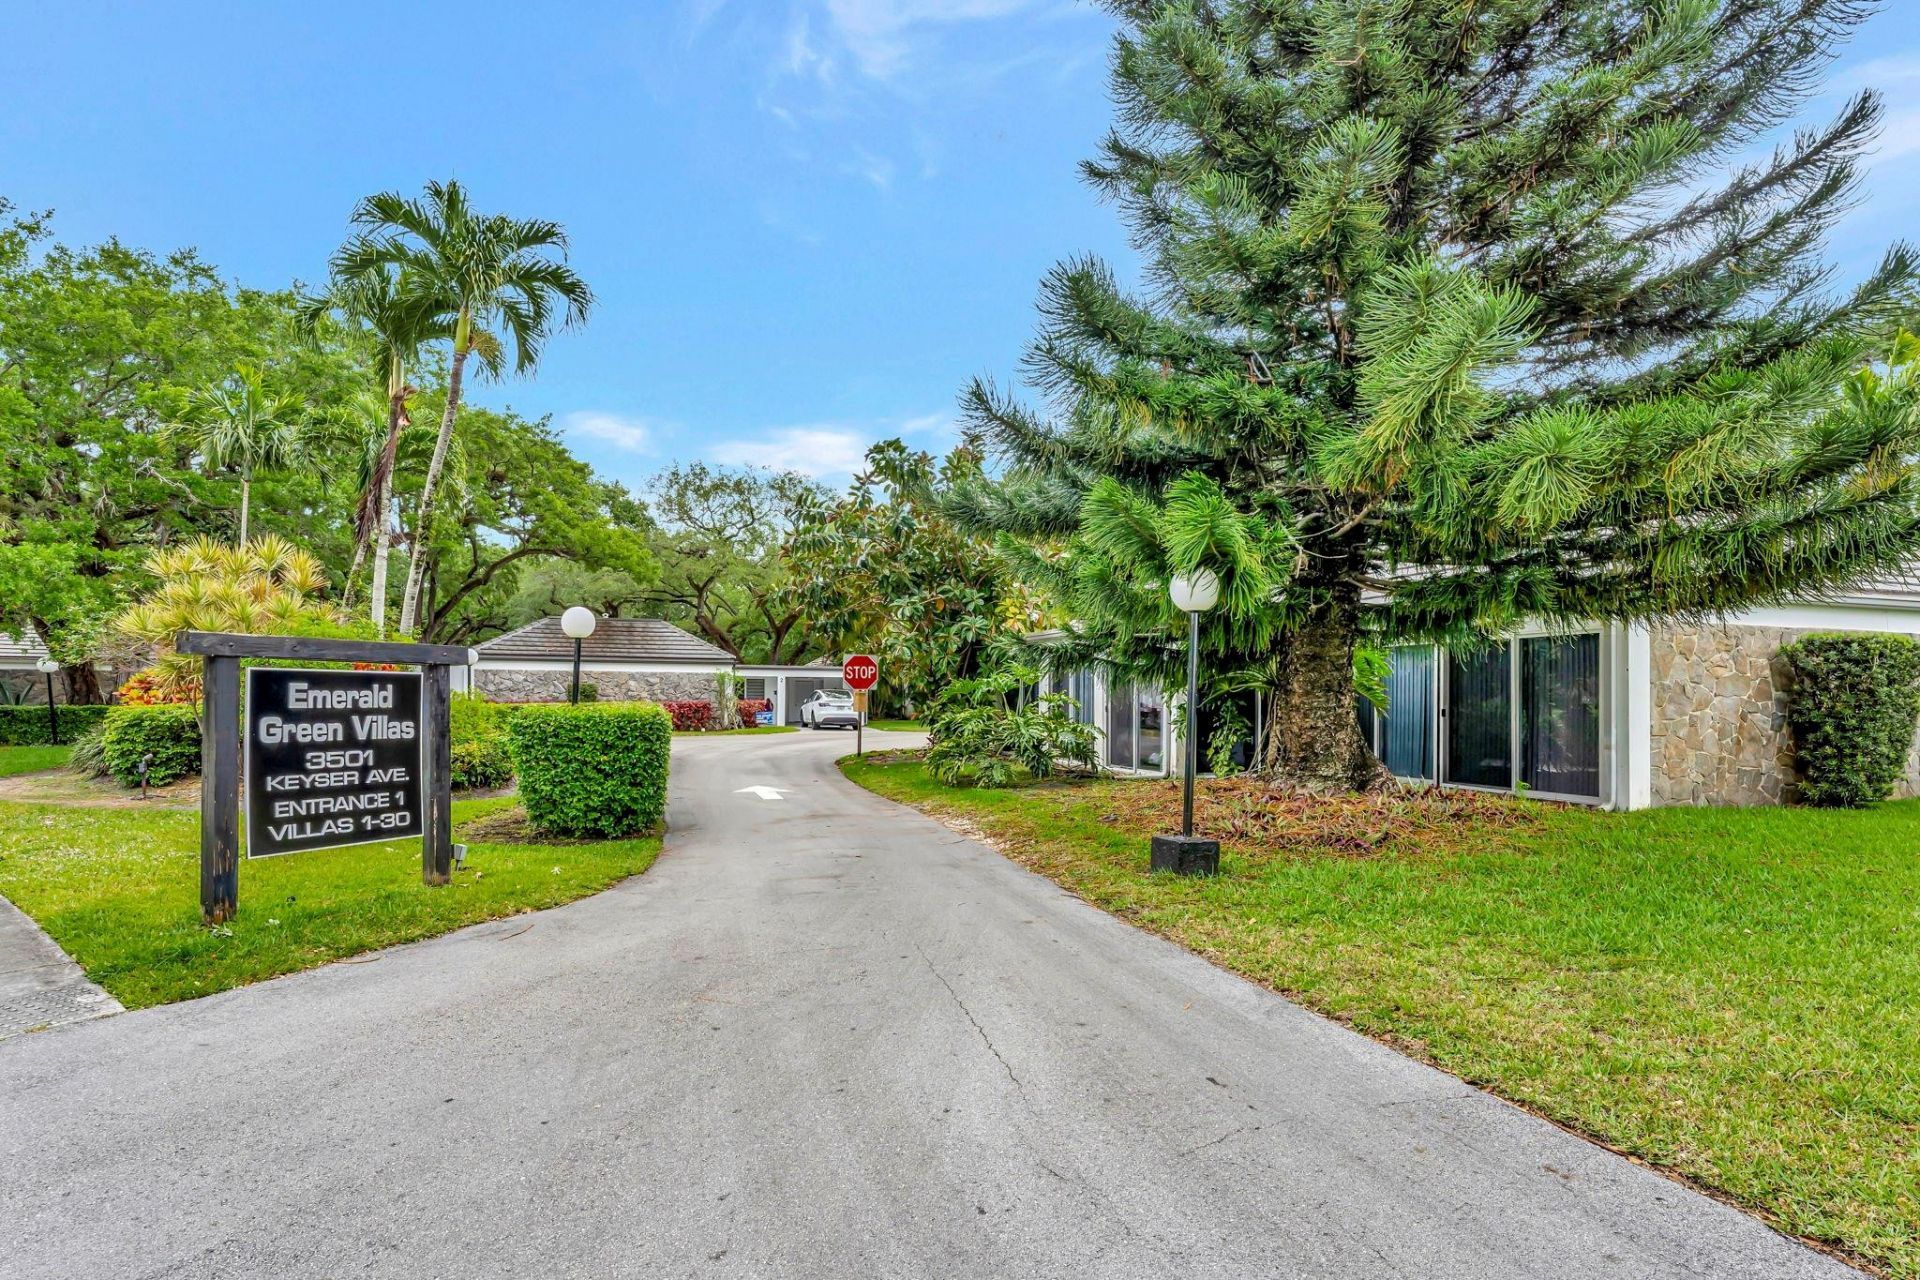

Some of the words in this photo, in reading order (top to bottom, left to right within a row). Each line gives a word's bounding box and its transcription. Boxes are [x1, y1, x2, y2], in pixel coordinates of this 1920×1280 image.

[846, 666, 876, 679] STOP
[288, 682, 393, 709] Emerald
[260, 716, 343, 743] Green
[351, 715, 415, 741] Villas
[306, 751, 374, 770] 3501
[266, 773, 359, 792] KEYSER
[366, 768, 410, 784] AVE.
[274, 793, 390, 818] ENTRANCE
[395, 791, 405, 806] 1
[268, 818, 353, 841] VILLAS
[361, 811, 411, 830] 1-30
